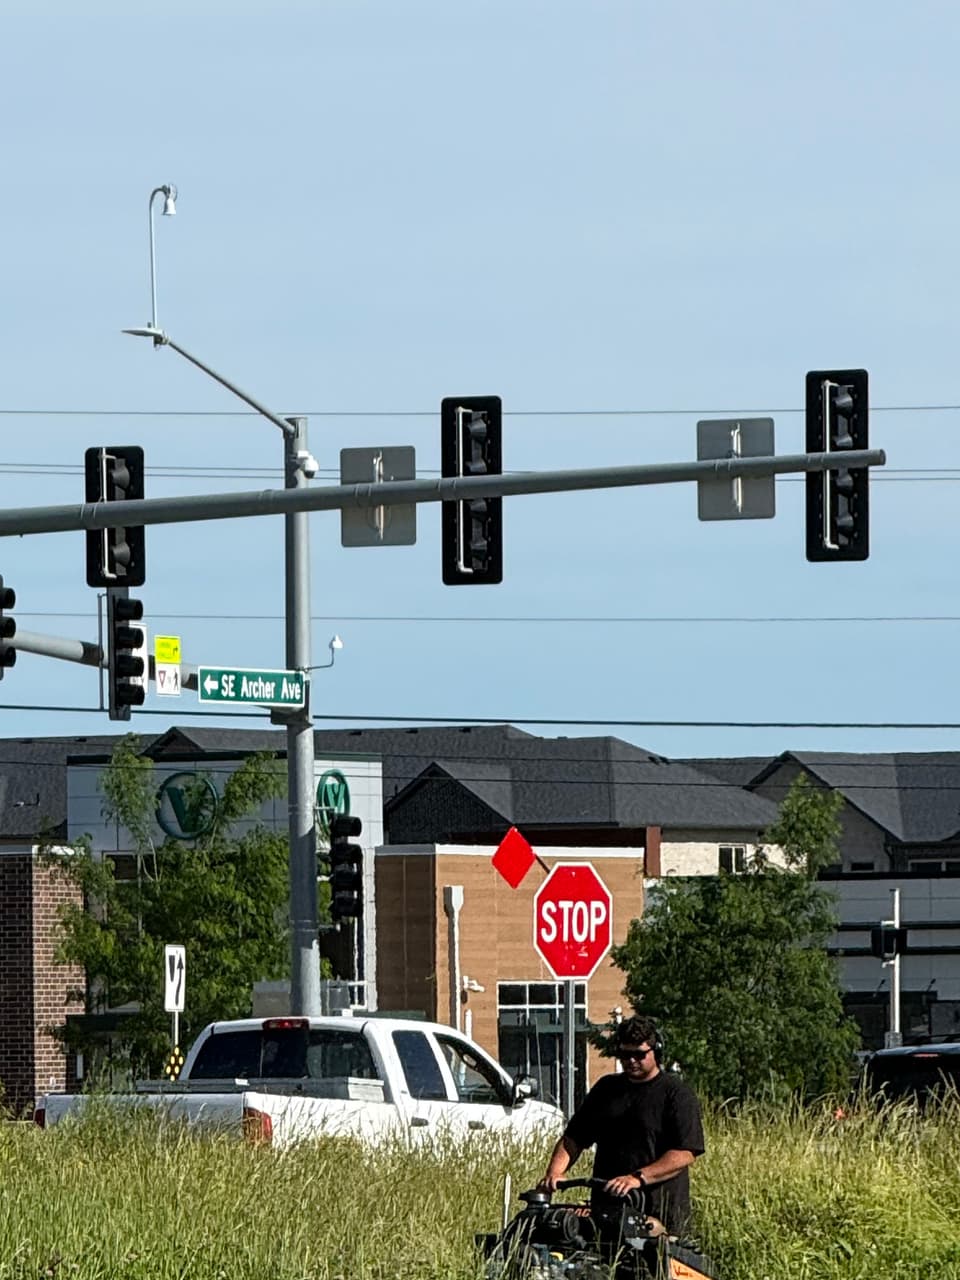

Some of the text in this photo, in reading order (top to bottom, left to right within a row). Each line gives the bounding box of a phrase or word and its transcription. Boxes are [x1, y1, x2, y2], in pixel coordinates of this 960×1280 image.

[221, 674, 301, 700] SE Archer Ave
[541, 901, 607, 943] STOP
